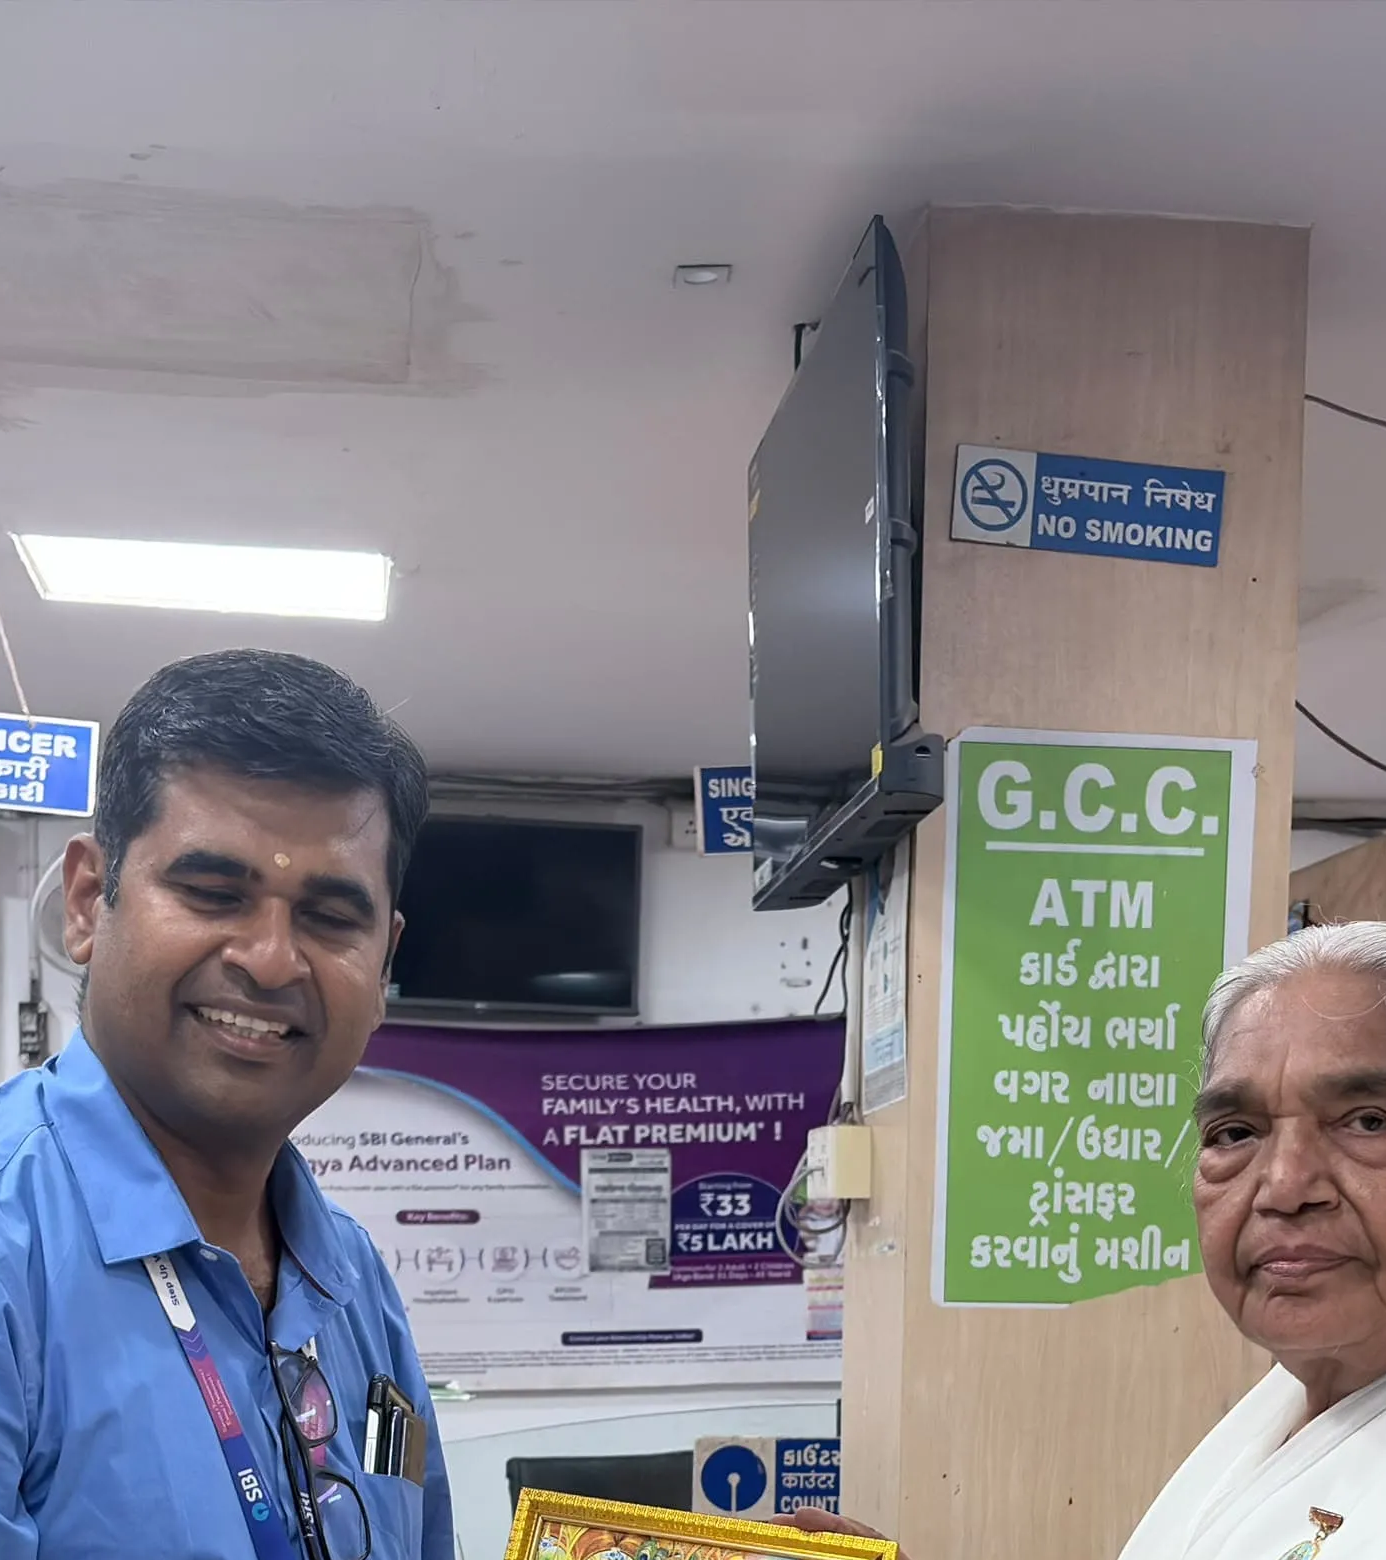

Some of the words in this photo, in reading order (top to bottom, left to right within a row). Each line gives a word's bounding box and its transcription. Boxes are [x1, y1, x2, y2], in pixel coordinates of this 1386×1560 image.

[1144, 478, 1216, 513] निषेध
[1037, 514, 1077, 539] NO
[1085, 519, 1213, 552] SMOKING
[978, 760, 1219, 835] G.C.C.
[1029, 878, 1154, 929] ATM
[1019, 938, 1082, 987] કાર્ડ
[1088, 951, 1160, 990] દ્વારા
[998, 1000, 1091, 1052] પહોંચ
[1105, 1003, 1181, 1050] ભર્યા
[541, 1074, 628, 1091] SECURE
[633, 1073, 697, 1090] YOUR
[994, 1070, 1070, 1104] વગર
[1087, 1073, 1176, 1108] નાણા
[645, 1095, 742, 1115] HEALTH,
[744, 1093, 805, 1111] WITH
[359, 1132, 387, 1146] SBI
[543, 1128, 559, 1147] A
[564, 1124, 630, 1146] FLAT
[349, 1154, 459, 1173] Advanced
[464, 1153, 511, 1173] Plan
[1029, 1167, 1136, 1228] ટ્રાંસફર
[707, 1231, 773, 1251] LAKH
[970, 1222, 1082, 1284] કરવાનું
[1094, 1224, 1190, 1271] મશીન
[159, 1264, 169, 1280] Up
[164, 1281, 180, 1306] Step
[237, 1468, 264, 1502] SBI
[782, 1471, 836, 1489] काउंटर
[781, 1495, 839, 1513] COUNT
